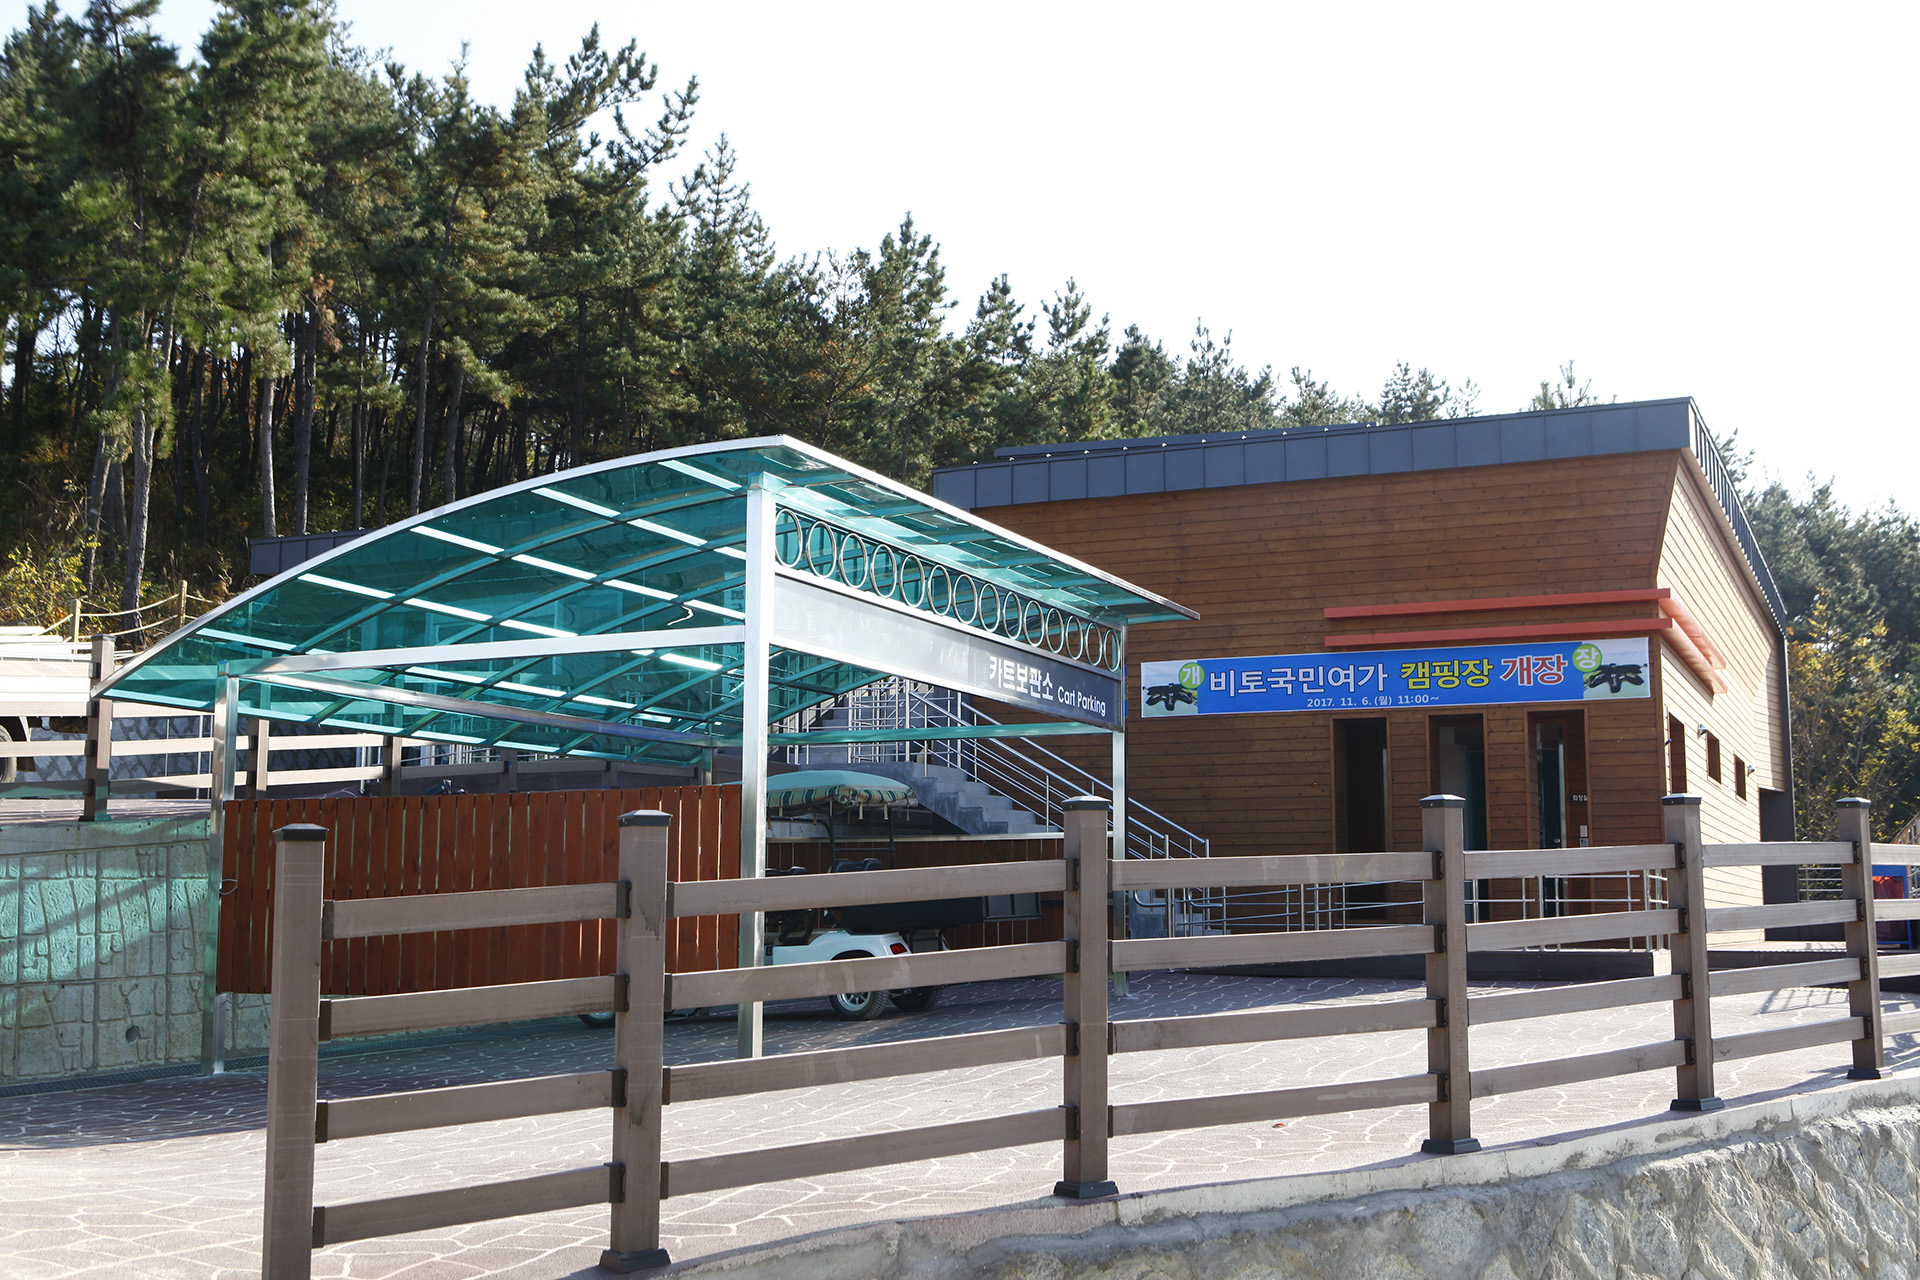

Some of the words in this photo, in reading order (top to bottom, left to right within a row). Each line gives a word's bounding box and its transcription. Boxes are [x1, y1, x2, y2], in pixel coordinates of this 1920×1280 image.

[1576, 647, 1599, 669] 장
[989, 655, 1054, 701] 카트보관소
[1182, 666, 1199, 686] 개
[1209, 663, 1389, 697] 비토국민여가
[1400, 658, 1494, 690] 캠핑장
[1500, 654, 1568, 686] 개장
[1057, 685, 1076, 707] Cart
[1077, 691, 1106, 717] Parking
[1307, 698, 1335, 708] 2017.
[1340, 697, 1357, 707] 11.
